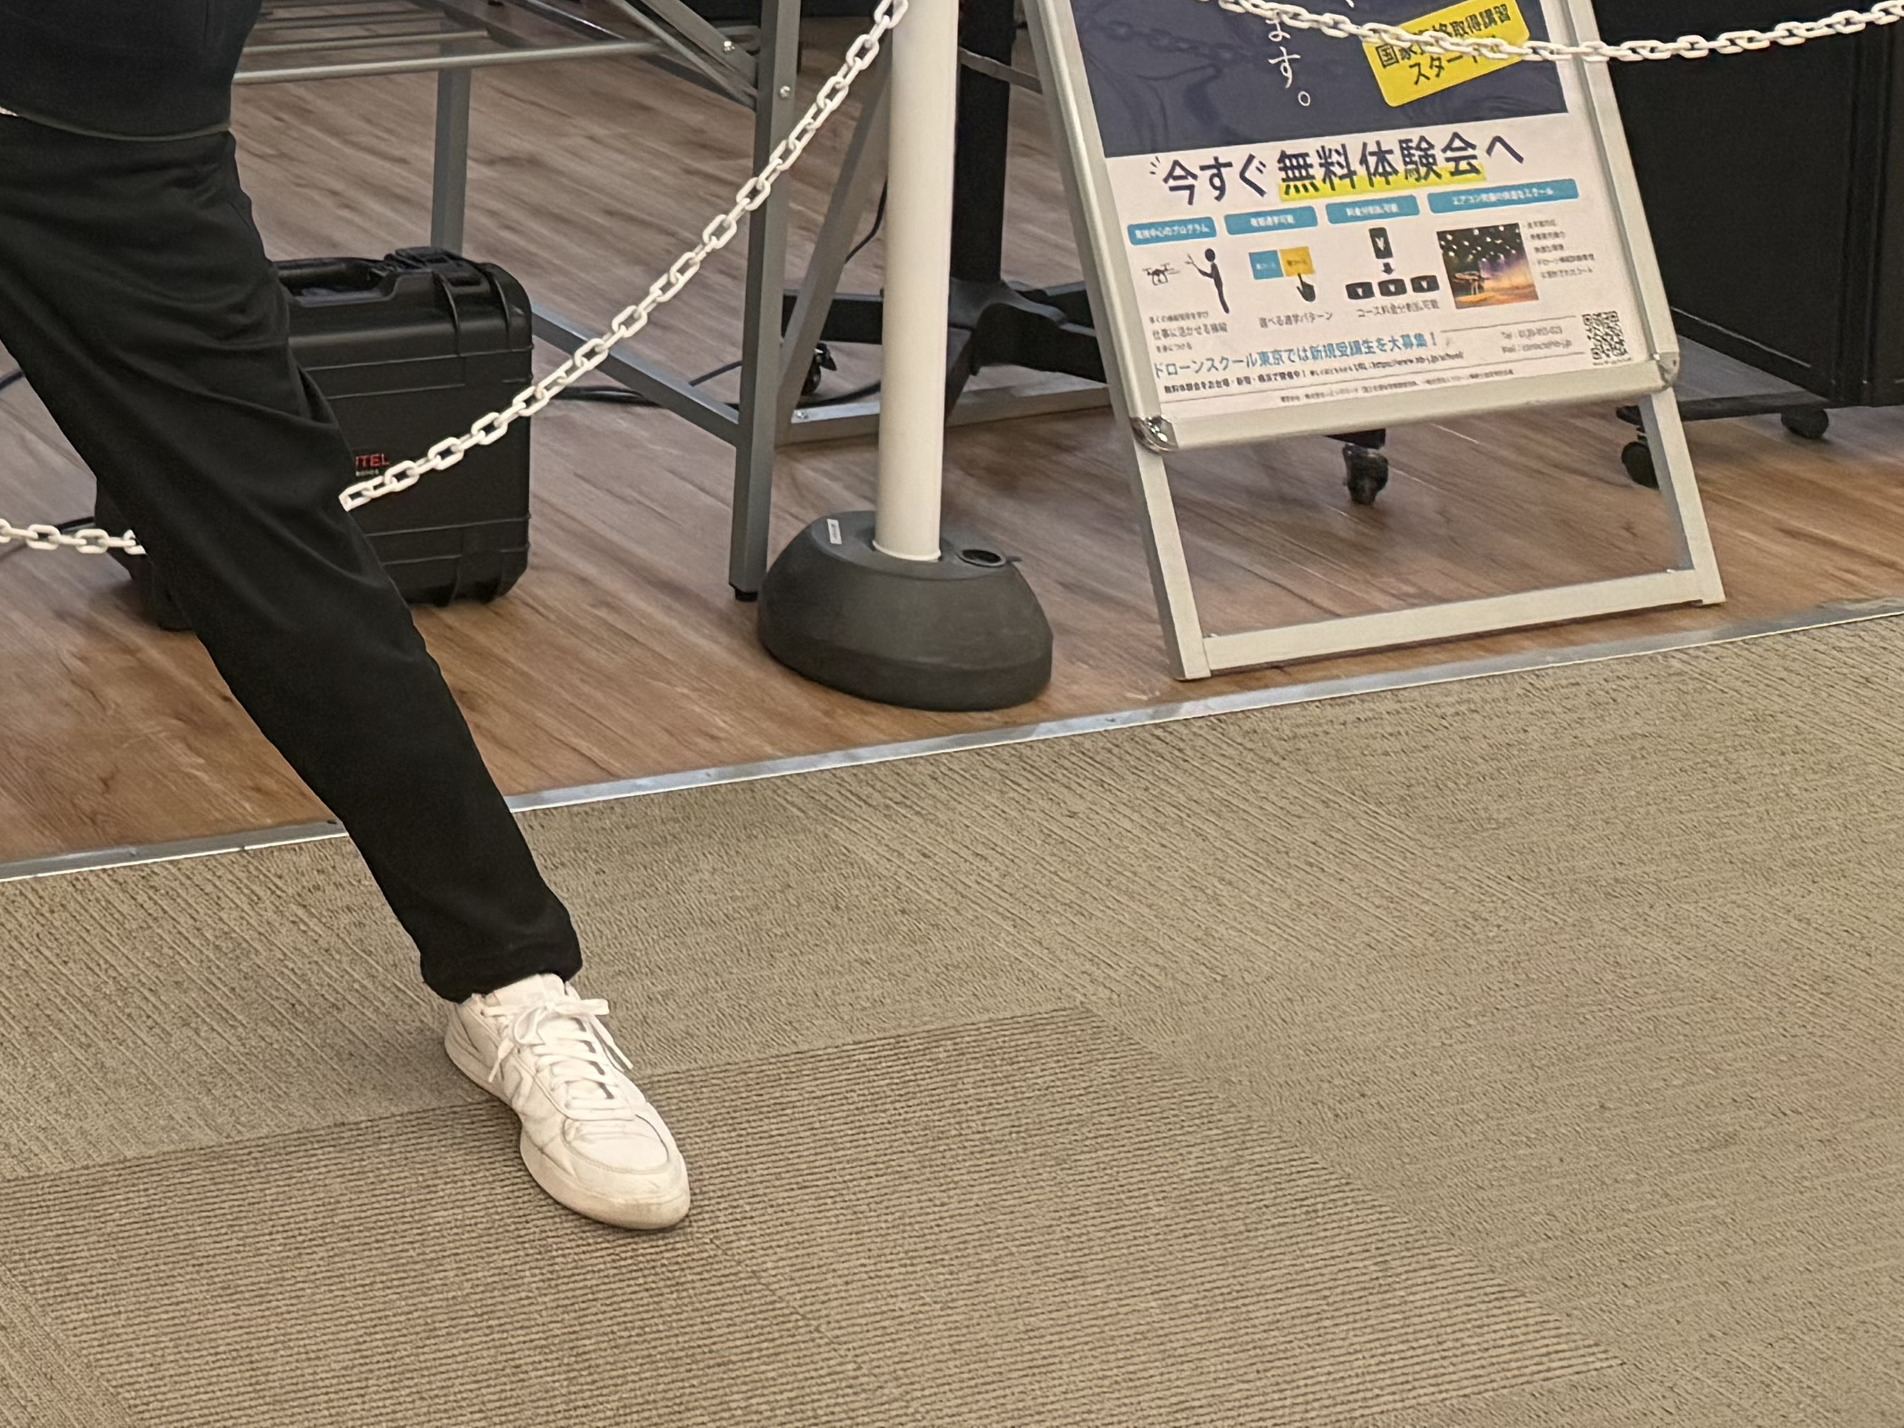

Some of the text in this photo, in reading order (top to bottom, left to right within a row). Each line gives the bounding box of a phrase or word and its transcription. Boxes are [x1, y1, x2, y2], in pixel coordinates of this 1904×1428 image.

[1162, 131, 1525, 206] 今すぐ無料体験会へ
